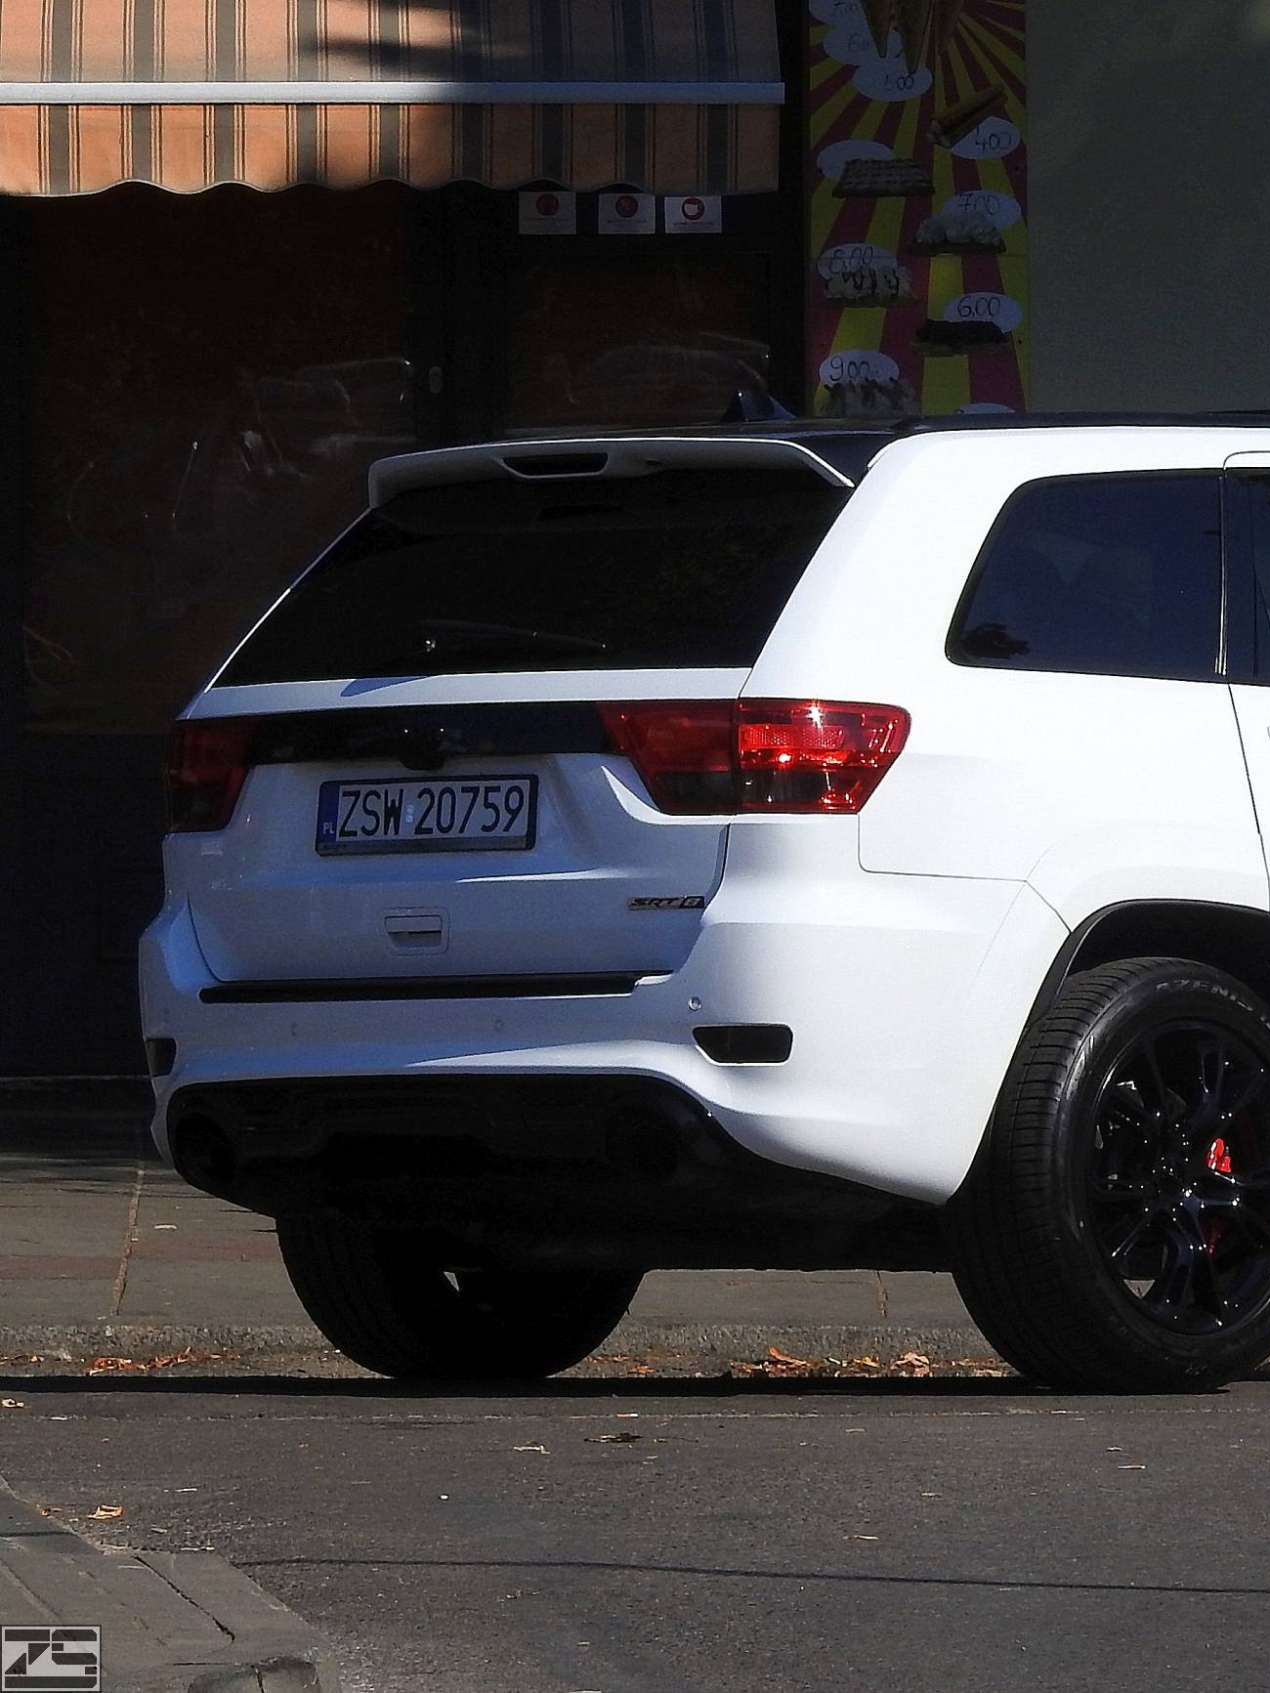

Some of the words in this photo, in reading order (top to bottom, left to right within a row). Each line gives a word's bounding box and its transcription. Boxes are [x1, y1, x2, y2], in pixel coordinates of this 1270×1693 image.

[323, 821, 336, 835] PL
[338, 788, 404, 838] ZSW
[414, 785, 525, 836] 20759
